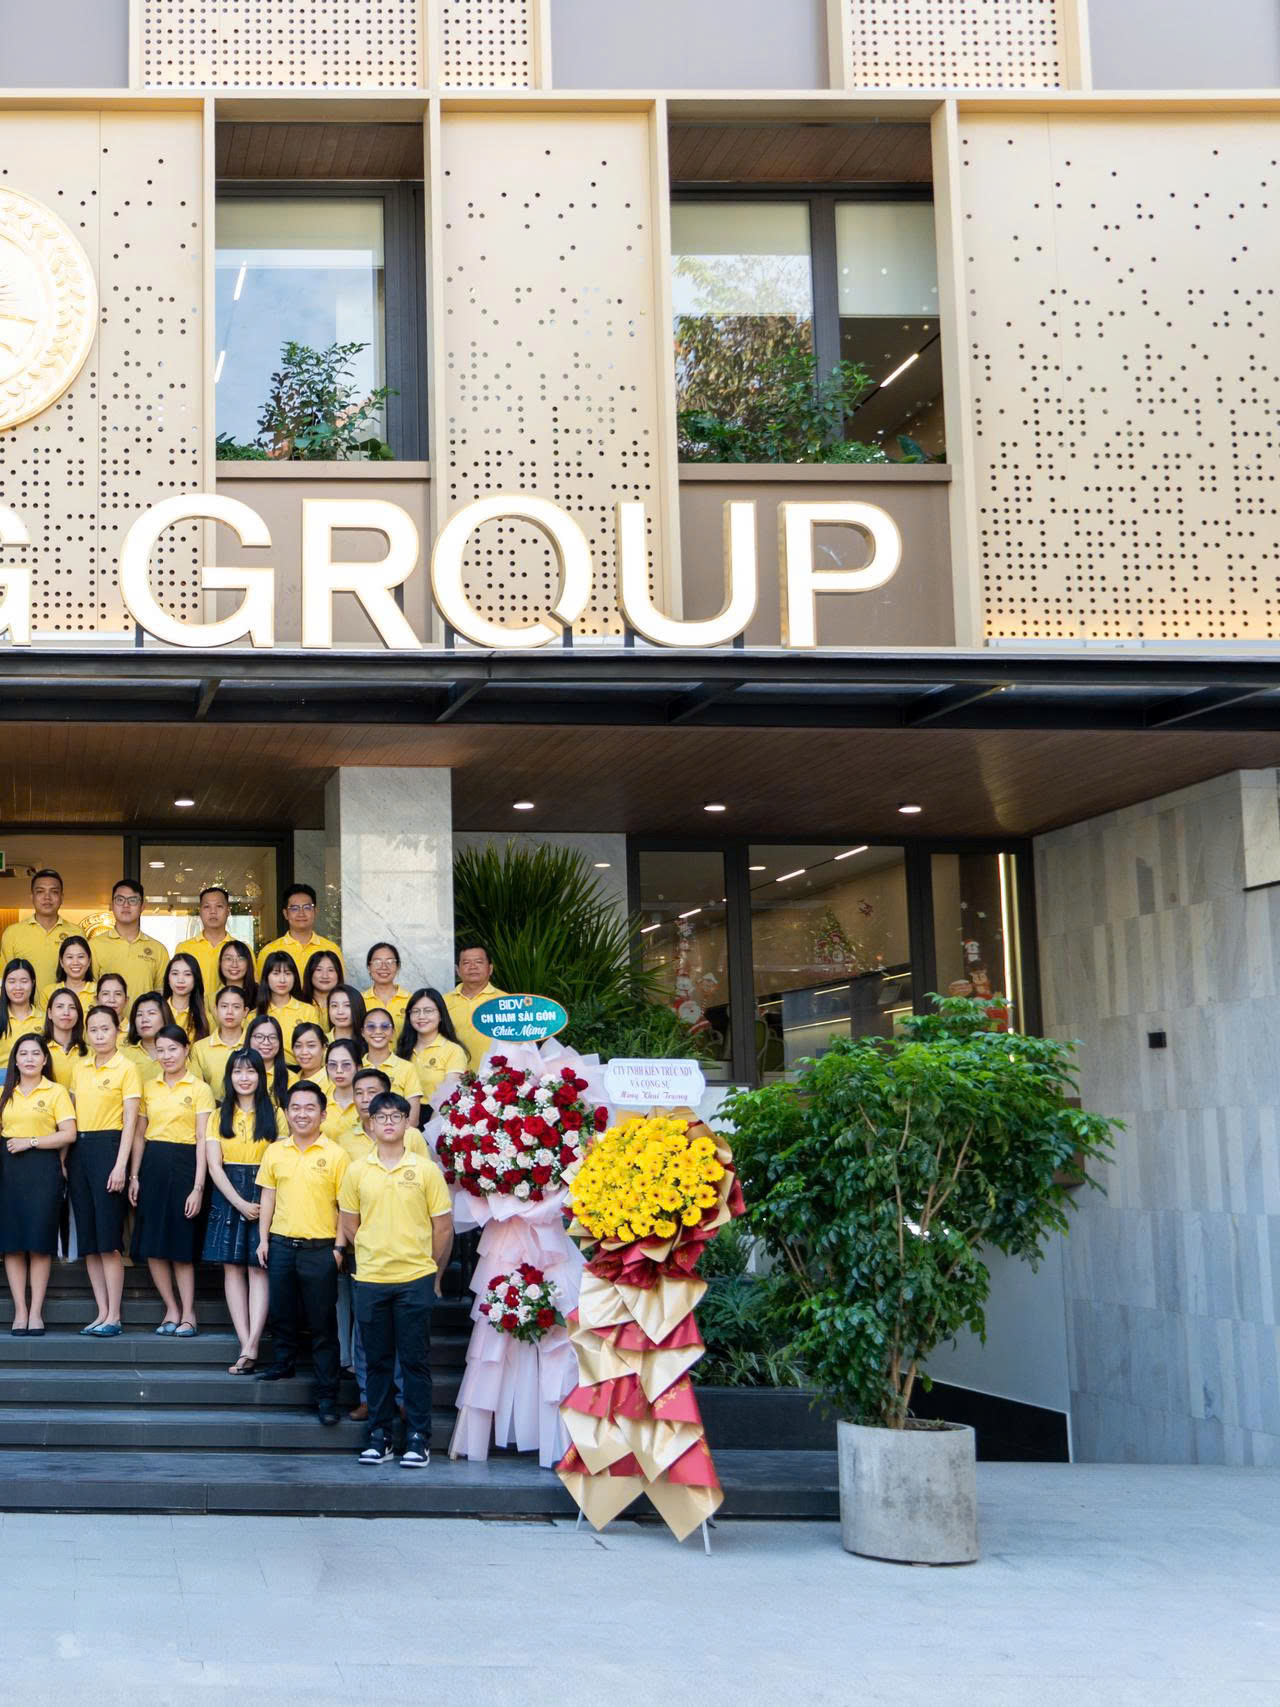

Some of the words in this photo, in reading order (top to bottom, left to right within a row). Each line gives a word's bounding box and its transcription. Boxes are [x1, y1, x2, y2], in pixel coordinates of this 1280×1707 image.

[119, 493, 903, 650] GROUP
[498, 998, 523, 1010] BIDV
[481, 1013, 494, 1023] CN
[495, 1012, 516, 1022] NAM
[518, 1010, 534, 1021] SÀI
[536, 1009, 556, 1021] GÒN
[491, 1025, 516, 1037] Chúc
[515, 1023, 547, 1038] Mừng
[613, 1065, 626, 1076] CTY
[626, 1065, 644, 1076] TNHH
